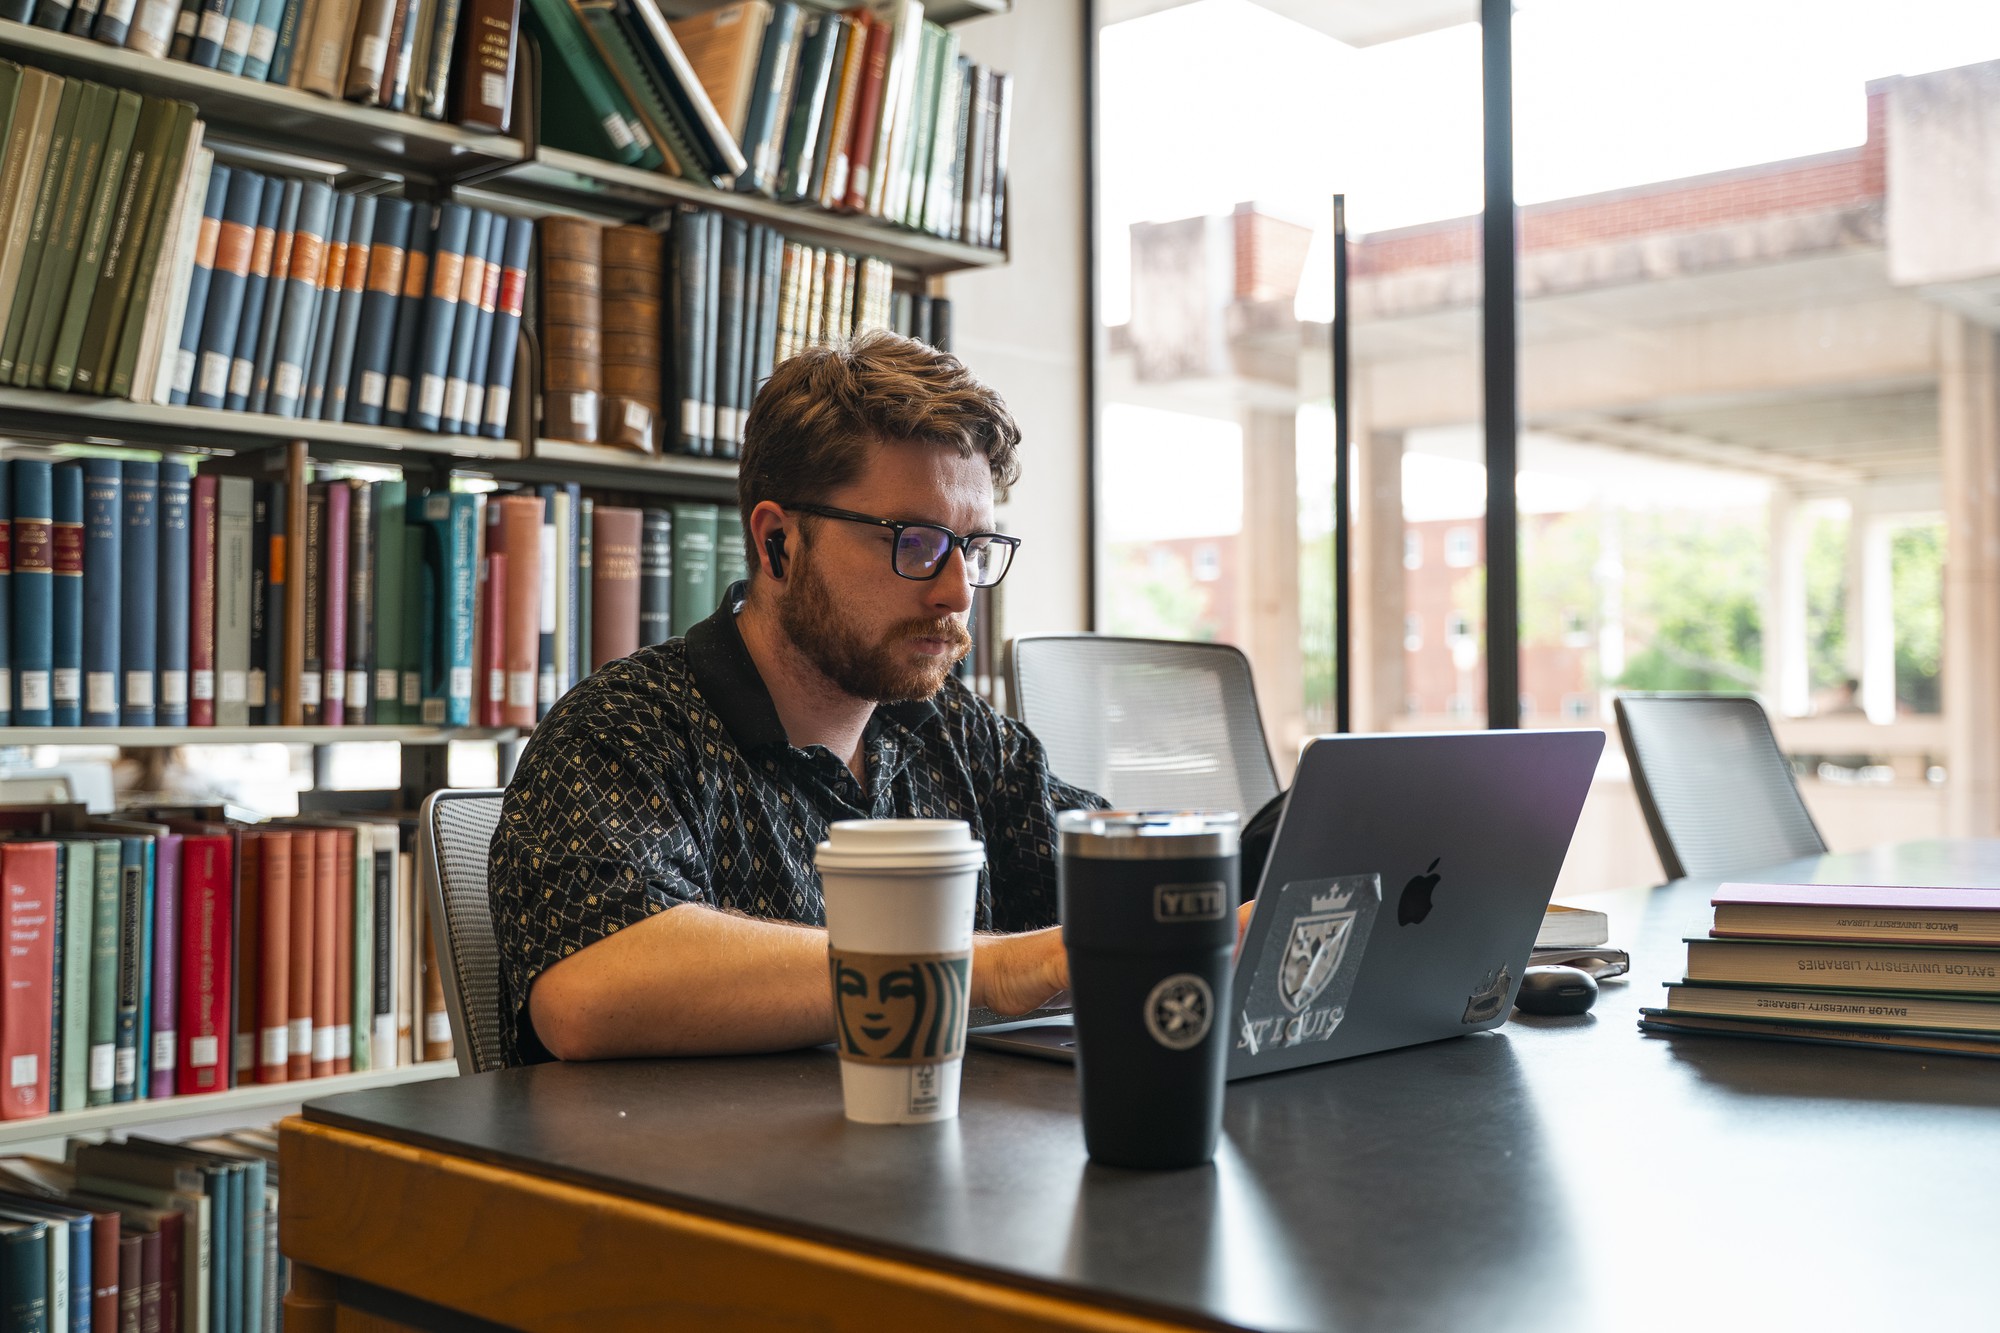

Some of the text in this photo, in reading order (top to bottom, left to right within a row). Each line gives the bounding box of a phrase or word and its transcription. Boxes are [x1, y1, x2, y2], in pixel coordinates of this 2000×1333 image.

[1161, 891, 1220, 917] YETI
[1836, 918, 1959, 932] BAYLOR UNIVERSITY LIBRARY
[1797, 959, 1997, 978] BAYLOR UNIVERSITY LIBRARIES
[1756, 999, 1908, 1017] BAYLOR UNIVERSITY LIBRARIES
[1236, 1006, 1344, 1051] ST LOUIS
